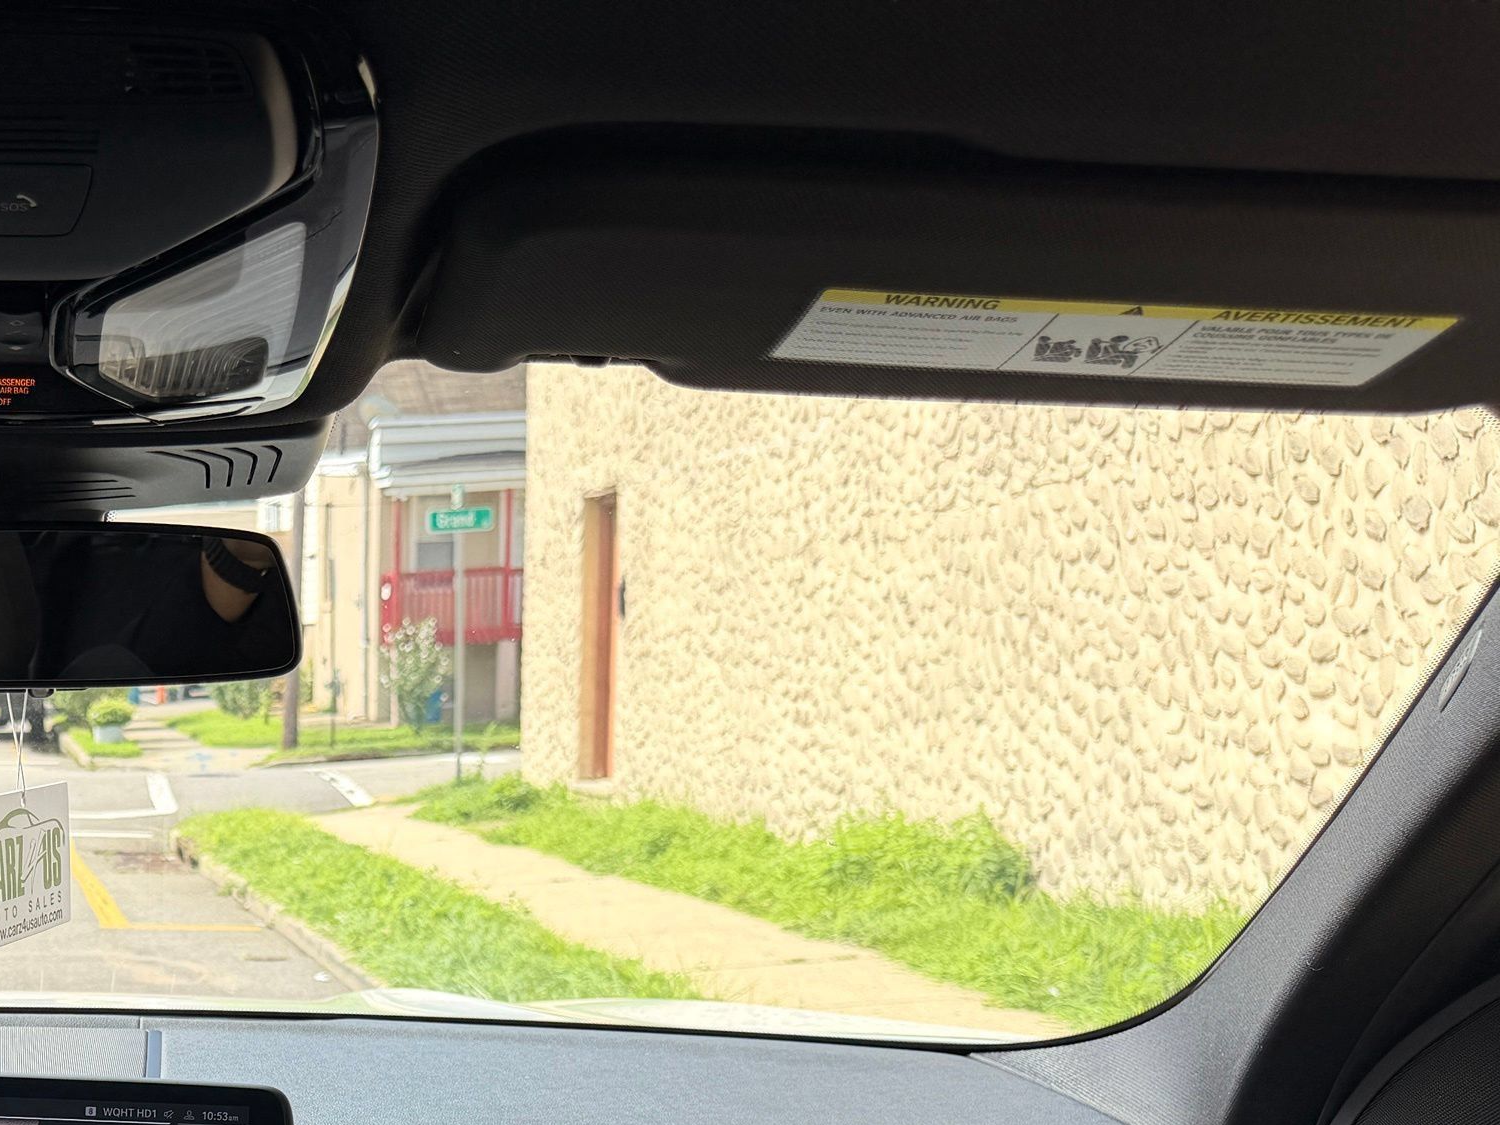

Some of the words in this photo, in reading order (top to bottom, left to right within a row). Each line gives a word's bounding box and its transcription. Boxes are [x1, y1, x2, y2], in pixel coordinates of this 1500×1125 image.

[0, 202, 28, 212] SOS
[884, 294, 1001, 311] WARNING
[819, 305, 852, 315] EVEN
[856, 308, 887, 316] WITH
[891, 310, 955, 320] ADVANCED
[984, 315, 1018, 323] BAGS
[1212, 311, 1420, 328] AVERTISSEMENT
[0, 386, 13, 395] AIR
[14, 386, 29, 395] BAG
[28, 890, 62, 912] SALES
[102, 1107, 135, 1118] WQHT
[136, 1108, 157, 1118] HD1
